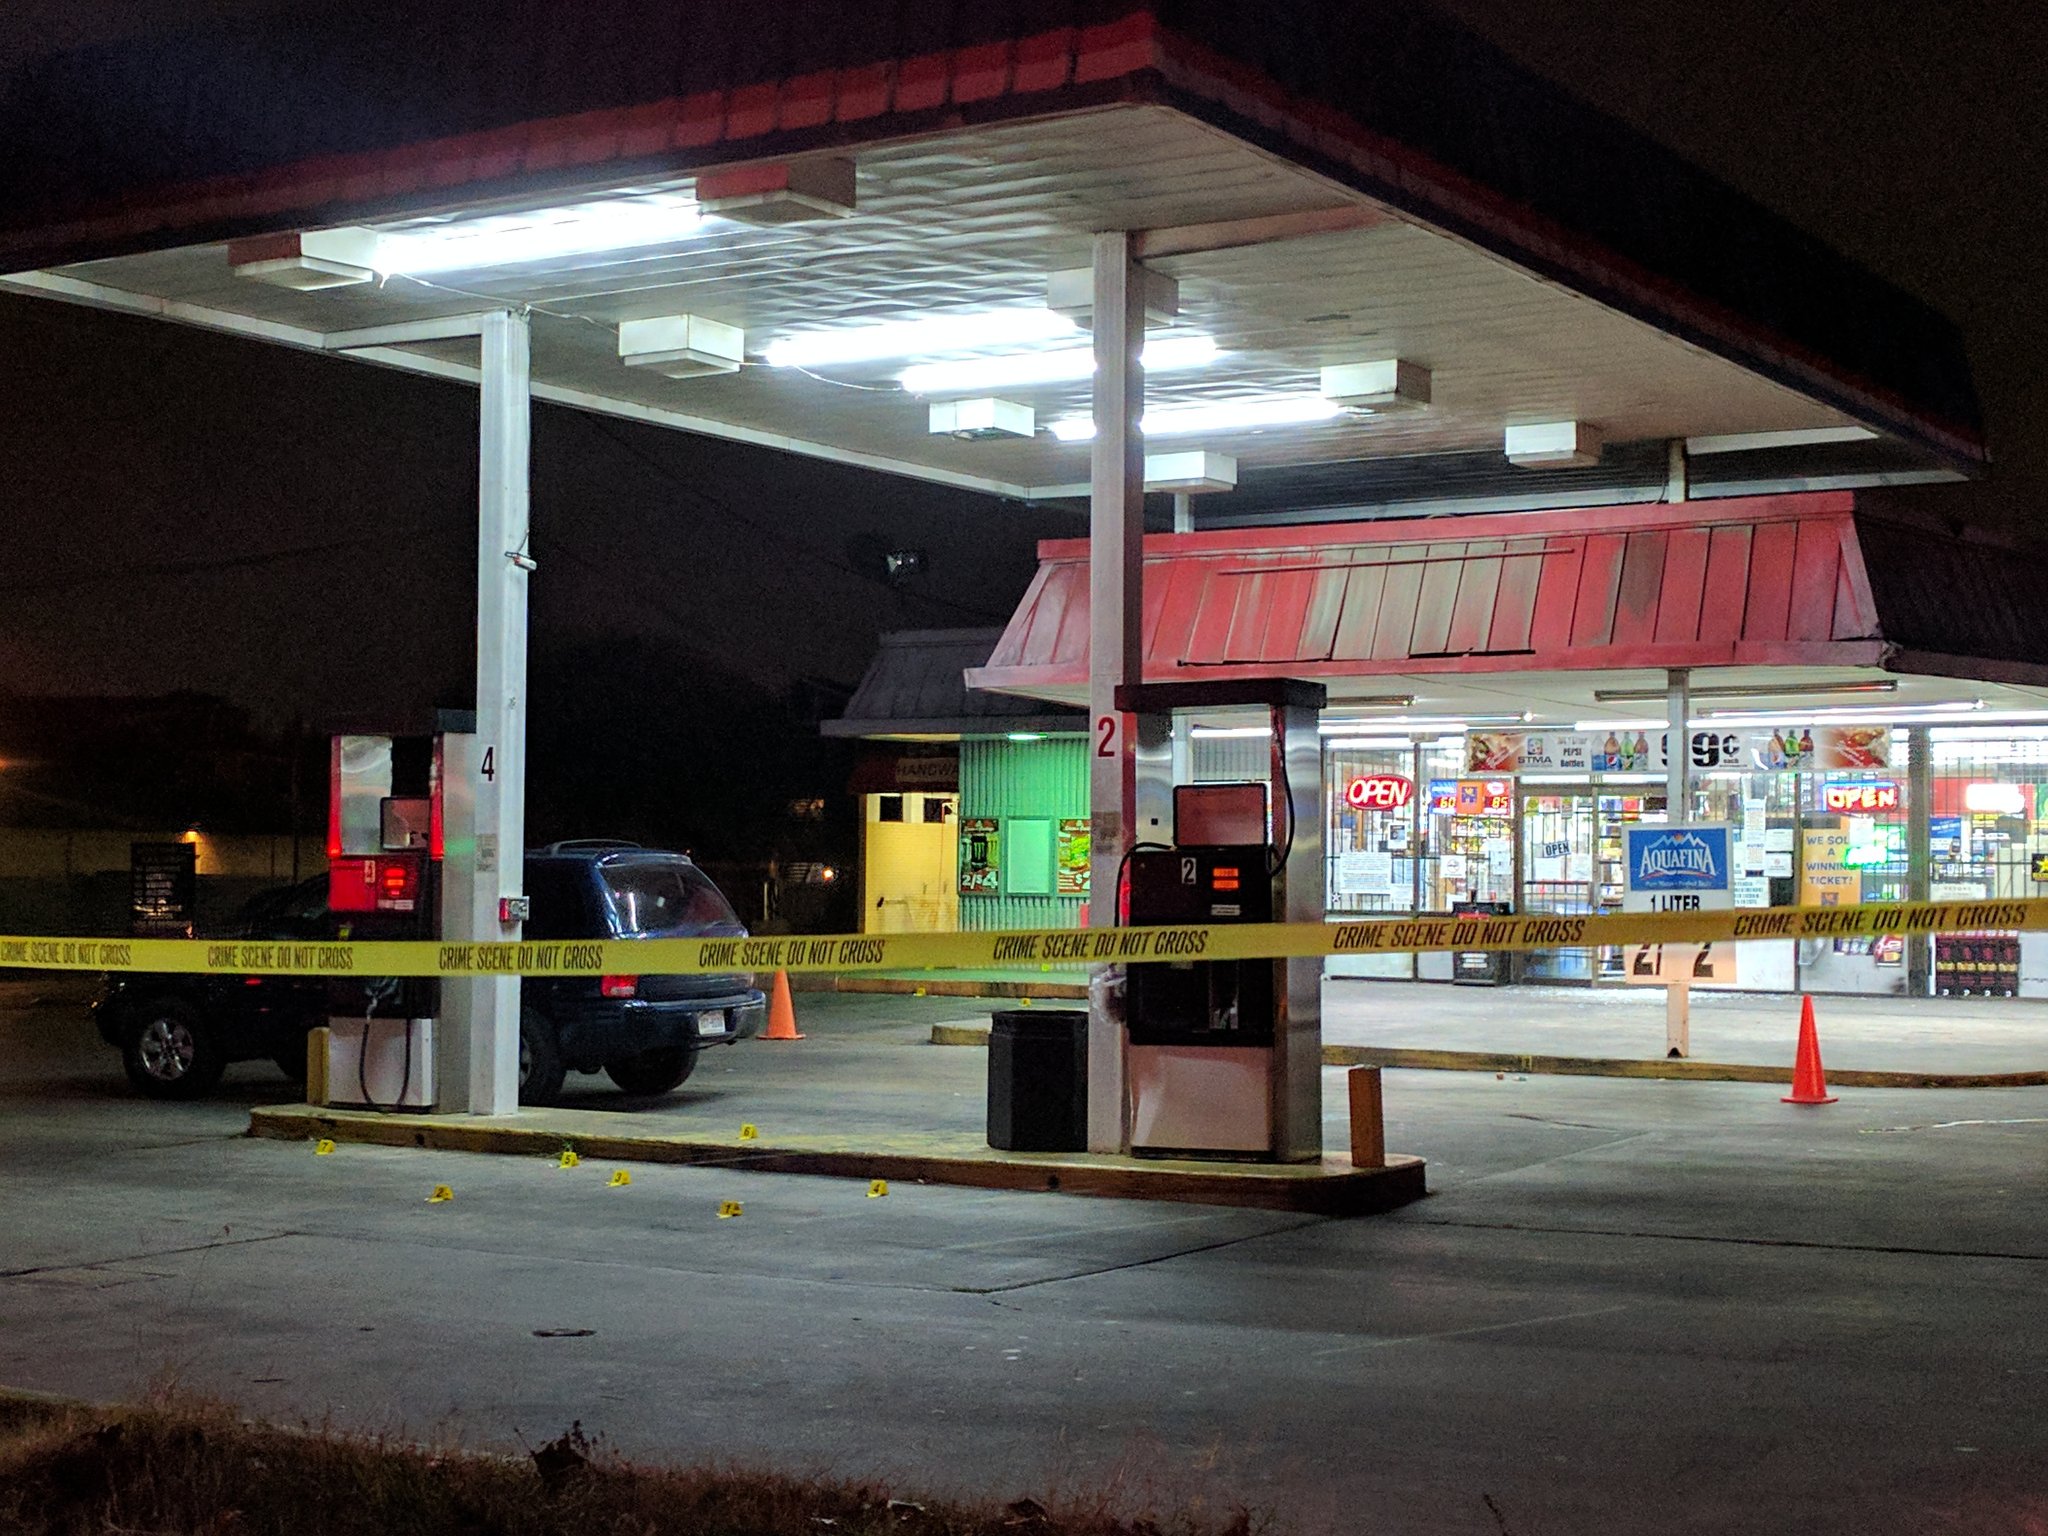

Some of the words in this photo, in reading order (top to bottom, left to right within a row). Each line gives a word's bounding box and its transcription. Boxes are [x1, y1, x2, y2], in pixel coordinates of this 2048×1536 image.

[1098, 717, 1115, 757] 2
[1518, 756, 1552, 764] STMA
[1563, 748, 1582, 756] PEPSI
[481, 747, 494, 781] 4
[1350, 779, 1408, 805] OPEN
[1827, 787, 1895, 809] OPEN
[1545, 841, 1570, 856] OPEN
[1806, 836, 1824, 845] WE
[1828, 836, 1849, 845] SOL
[1827, 848, 1835, 856] A
[1183, 860, 1194, 882] 2
[1639, 845, 1717, 876] AQUAFINA
[1806, 863, 1846, 872] WINNIN
[1809, 877, 1852, 885] TICKET!
[1651, 894, 1656, 911] 1
[1662, 894, 1700, 911] LITER
[1734, 913, 1797, 936] CRIME
[1801, 911, 1867, 933] SCENE
[1873, 908, 1901, 930] DO
[1907, 906, 1950, 930] NOT
[1956, 903, 2027, 927] CROSS
[993, 935, 1041, 960] CRIME
[1042, 932, 1093, 958] SCENE
[1093, 932, 1116, 957] DO
[1118, 931, 1153, 955] NOT
[1154, 930, 1209, 954] CROSS
[1333, 926, 1387, 949] CRIME
[1390, 923, 1451, 947] SCENE
[1451, 922, 1478, 945] DO
[1480, 921, 1520, 944] NOT
[1522, 919, 1586, 943] CROSS
[32, 942, 60, 963] SCENE
[63, 943, 76, 963] DO
[79, 943, 98, 964] NOT
[101, 944, 131, 965] CROSS
[208, 946, 238, 967] CRIME
[241, 946, 274, 968] SCENE
[277, 946, 291, 968] DO
[294, 946, 316, 968] NOT
[318, 947, 353, 969] CROSS
[439, 946, 473, 970] CRIME
[477, 947, 514, 970] SCENE
[517, 946, 533, 970] DO
[536, 946, 561, 969] NOT
[563, 945, 603, 969] CROSS
[700, 942, 739, 967] CRIME
[742, 941, 785, 965] SCENE
[787, 941, 806, 965] DO
[808, 940, 838, 964] NOT
[838, 940, 885, 963] CROSS
